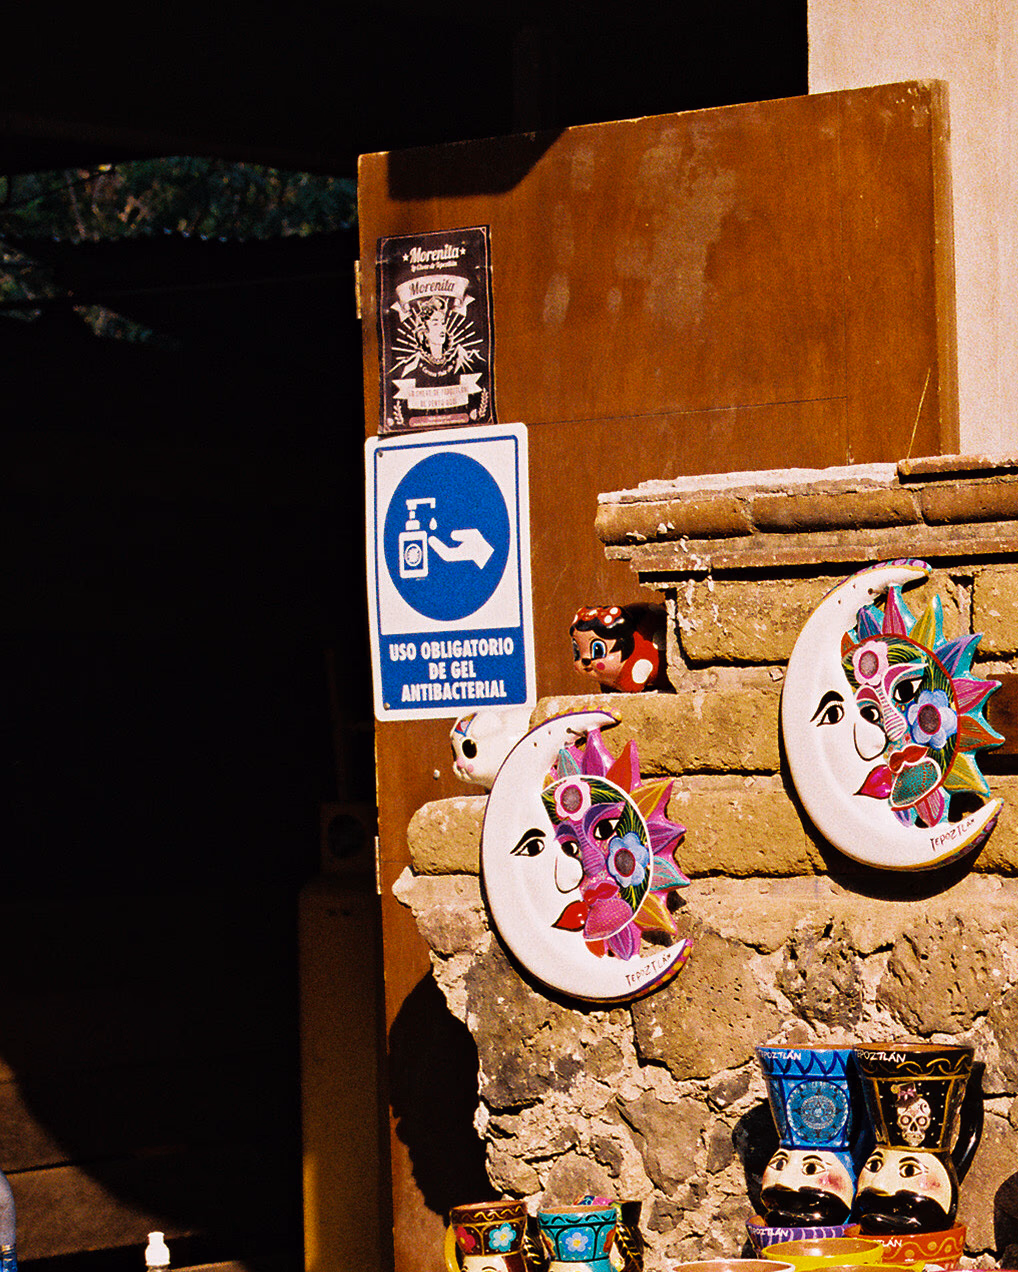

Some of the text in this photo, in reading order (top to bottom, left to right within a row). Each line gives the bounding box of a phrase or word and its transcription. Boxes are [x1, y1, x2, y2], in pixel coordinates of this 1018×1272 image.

[410, 244, 460, 264] Morenita
[409, 279, 455, 295] Morenita
[388, 637, 514, 661] USO OBLIGATORIO
[428, 660, 477, 680] DE GEL
[401, 680, 507, 702] ANTIBACTERIAL
